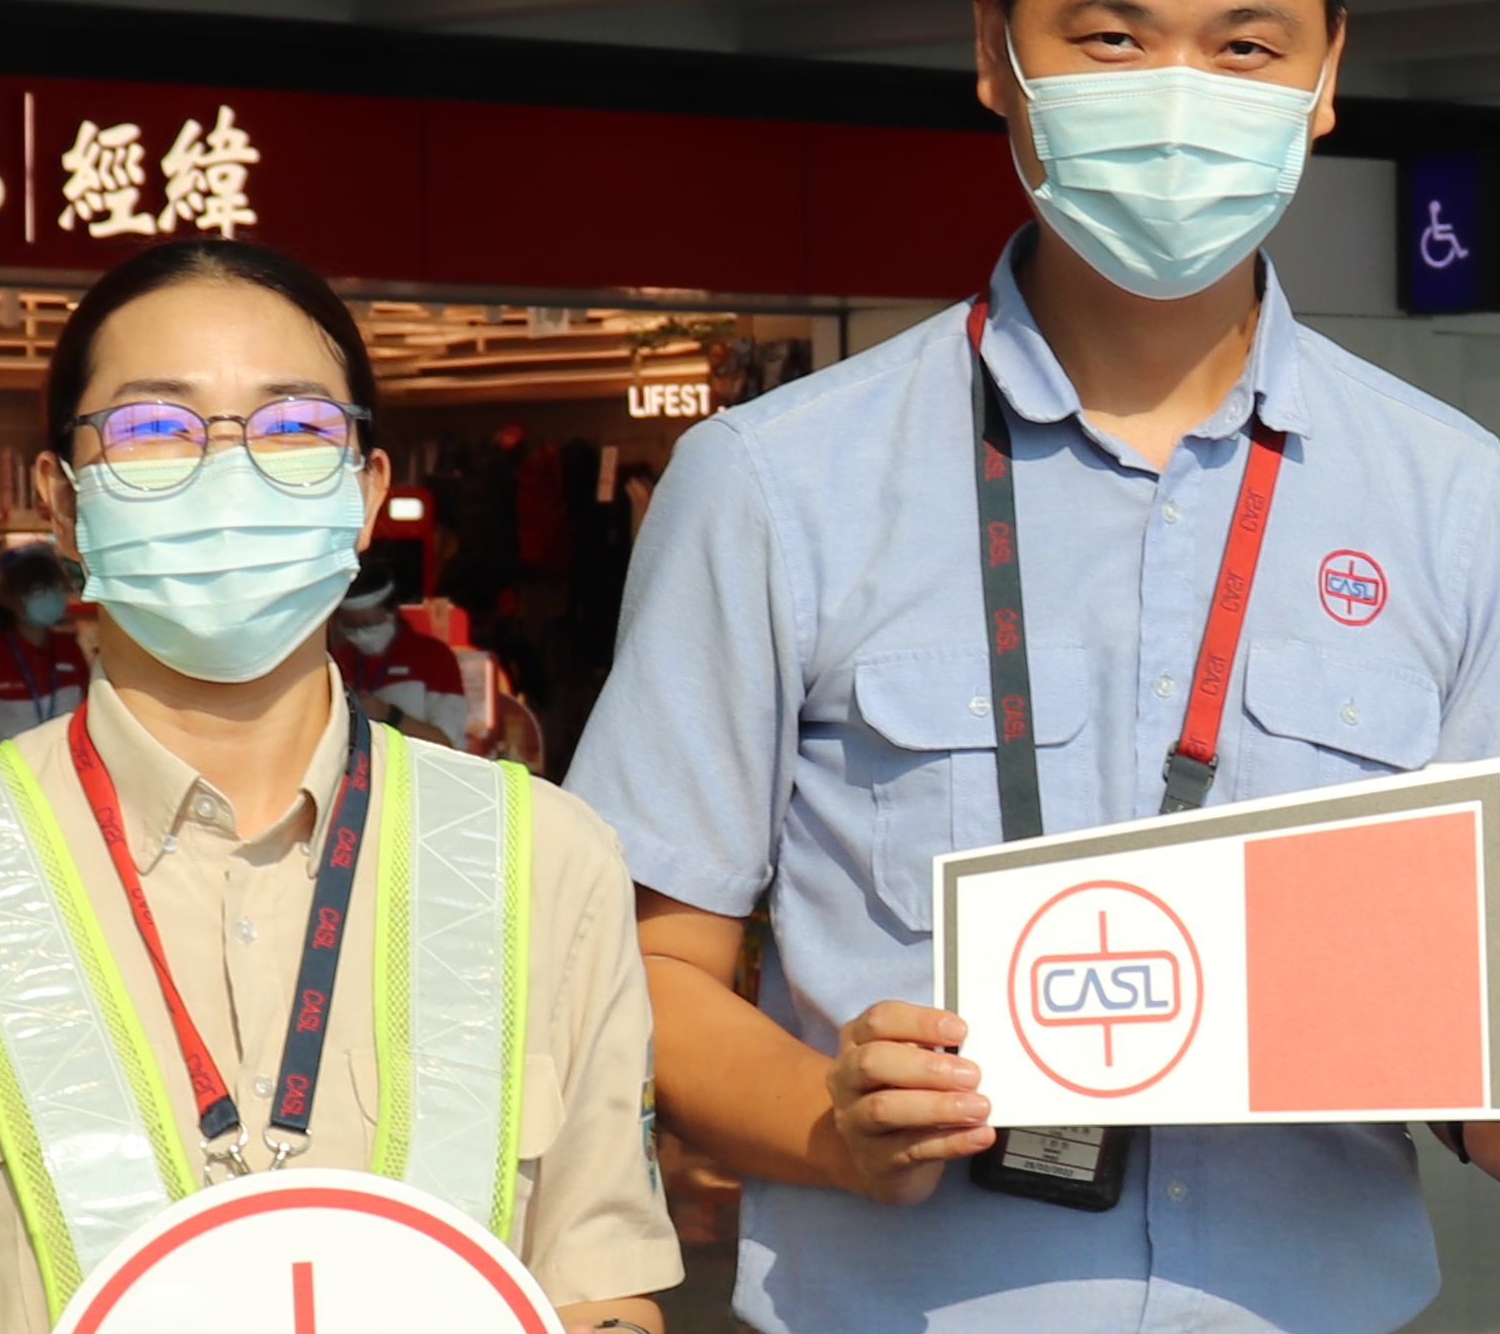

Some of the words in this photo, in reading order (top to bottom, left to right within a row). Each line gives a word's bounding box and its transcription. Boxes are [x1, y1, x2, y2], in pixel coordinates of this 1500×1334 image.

[57, 104, 260, 238] 經緯
[628, 383, 727, 418] LIFEST
[1330, 576, 1374, 600] CASL
[995, 609, 1020, 654] CASL
[1002, 696, 1027, 743] CASL
[329, 827, 358, 869] CASL
[312, 906, 342, 949] CASL
[1042, 964, 1169, 1013] CASL
[296, 989, 327, 1033] CASL
[280, 1073, 311, 1117] CASL
